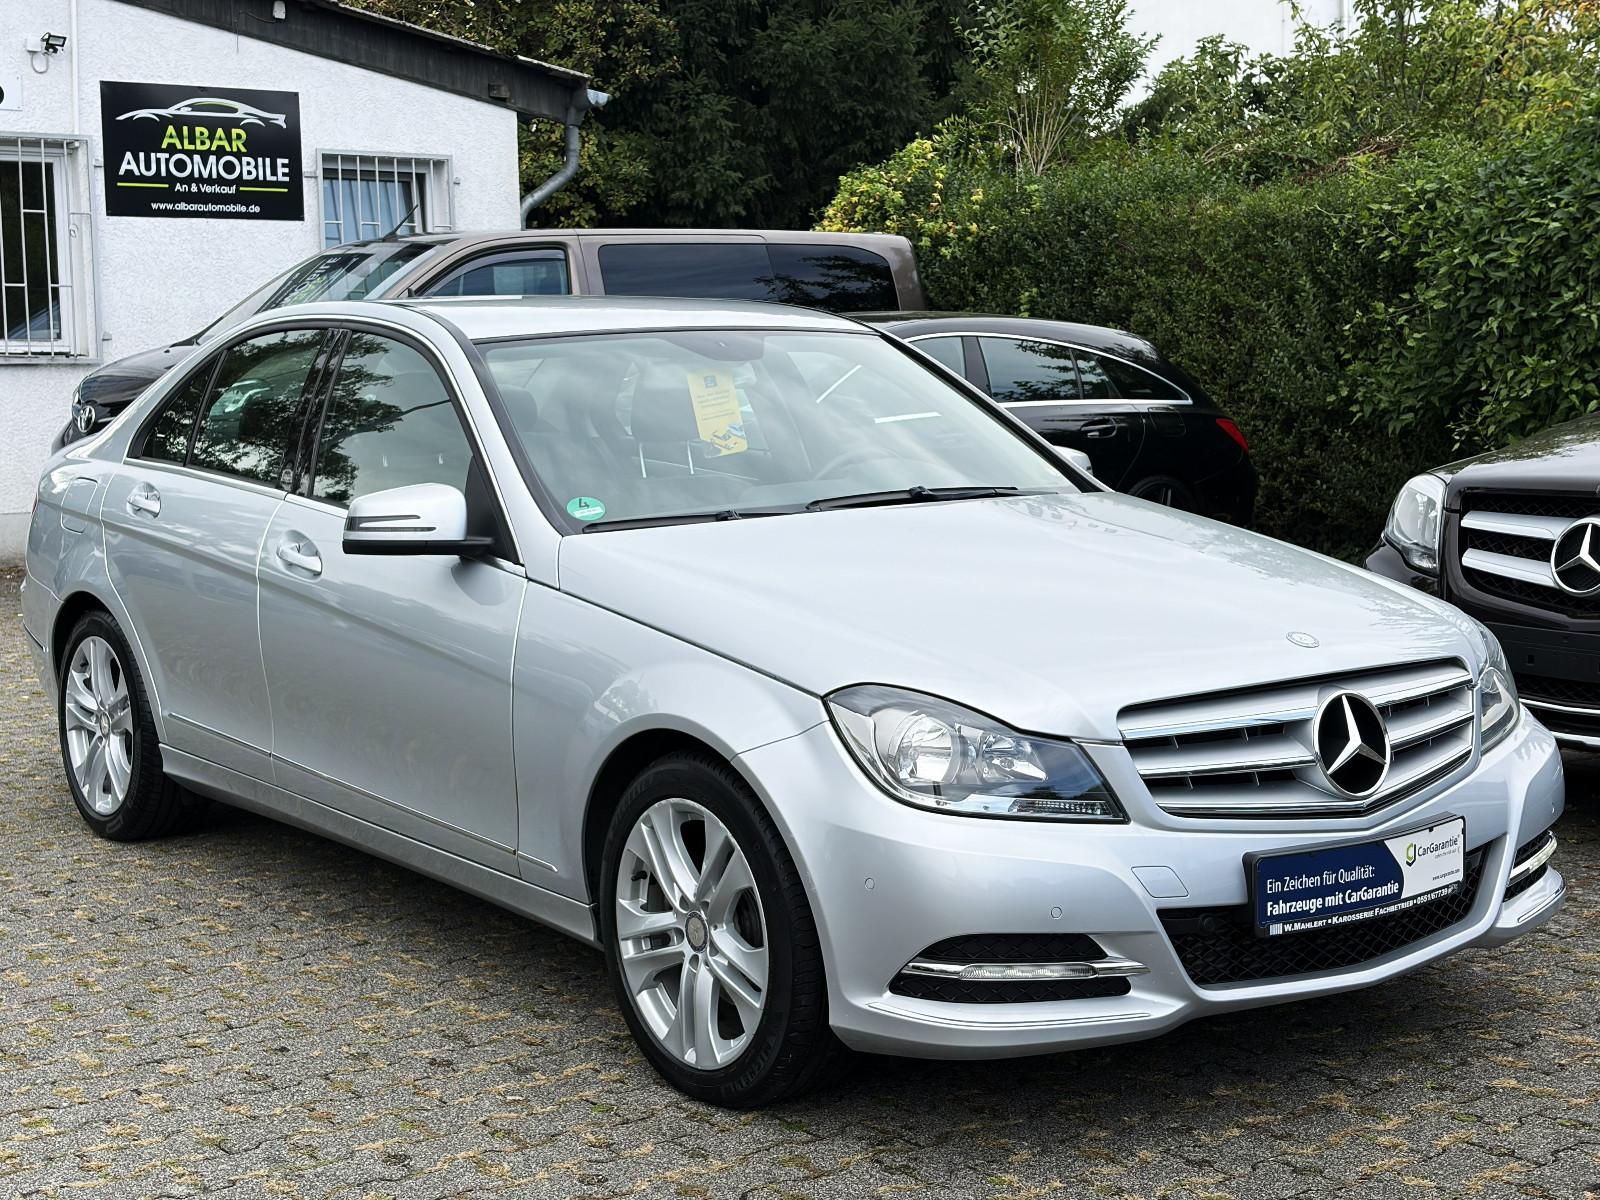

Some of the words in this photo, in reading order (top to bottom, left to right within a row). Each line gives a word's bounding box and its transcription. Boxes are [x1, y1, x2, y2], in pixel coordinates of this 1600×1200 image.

[161, 125, 247, 152] ALBAR
[118, 151, 290, 182] AUTOMOBILE
[174, 183, 189, 193] An
[190, 183, 198, 193] &
[199, 183, 237, 194] Verkauf
[151, 201, 260, 213] www.albarautomobile.de
[1267, 879, 1282, 894] Ein
[1283, 874, 1321, 892] Zeichen
[1322, 871, 1337, 886] für
[1338, 864, 1376, 884] Qualität:
[1267, 898, 1323, 916] Fahrzeuge
[1325, 891, 1344, 907] mit
[1345, 880, 1399, 903] CarGarantie
